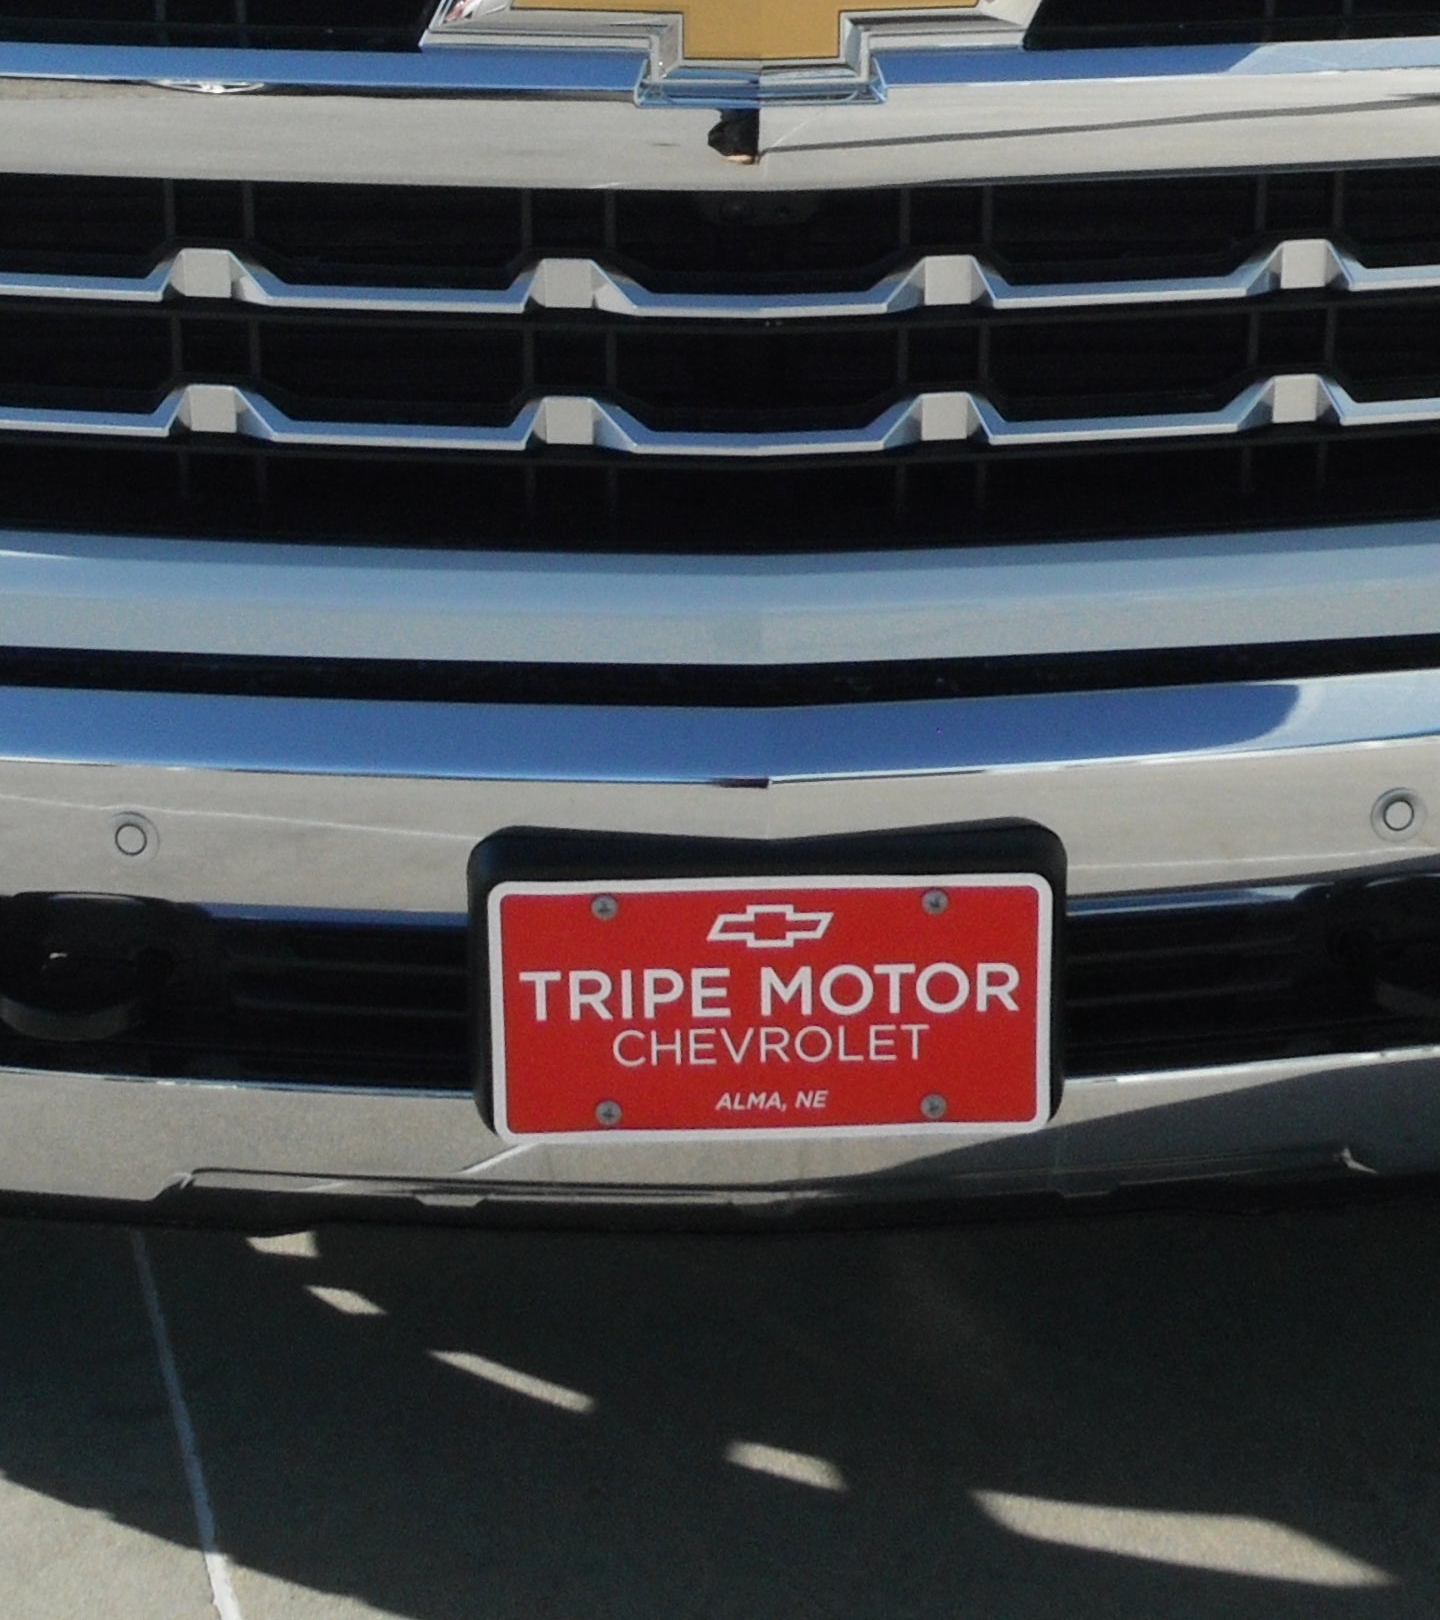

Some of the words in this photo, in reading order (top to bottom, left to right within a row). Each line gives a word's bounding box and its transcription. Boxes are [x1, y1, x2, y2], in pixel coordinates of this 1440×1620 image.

[519, 967, 732, 1022] TRIPE
[760, 962, 1020, 1017] MOTOR
[612, 1024, 930, 1067] CHEVROLET
[715, 1091, 787, 1112] ALMA,
[795, 1090, 829, 1109] NE
